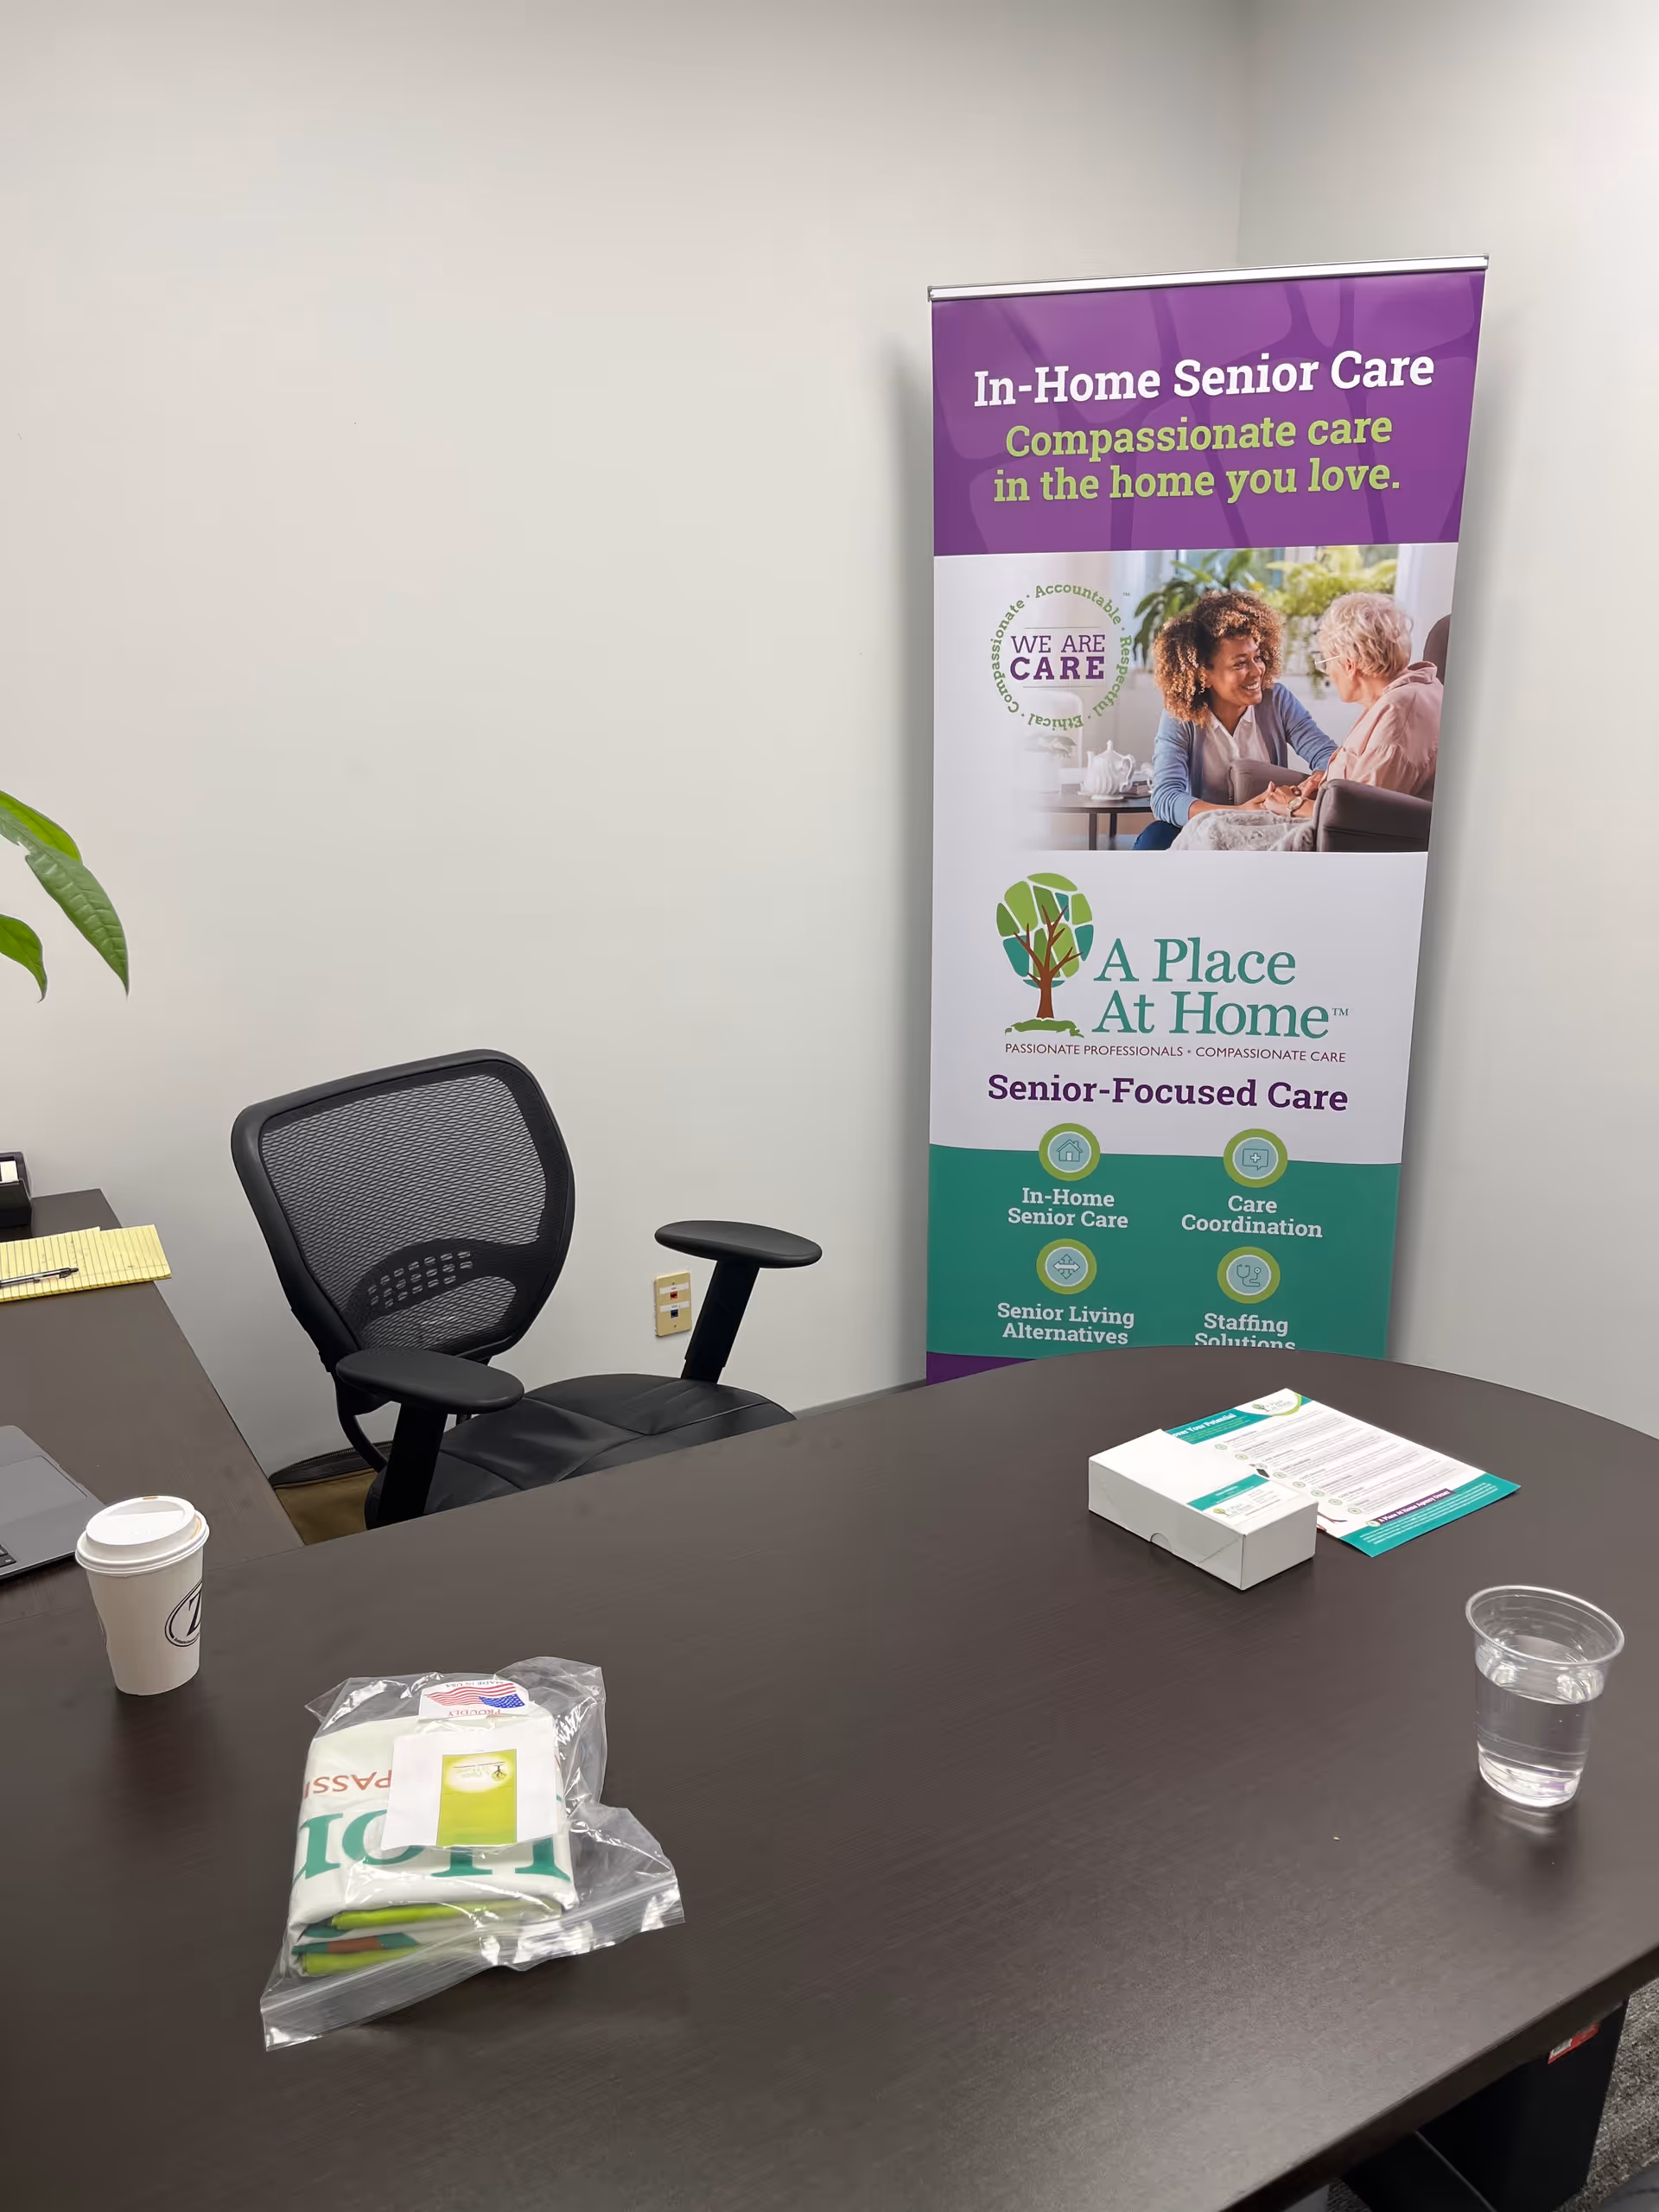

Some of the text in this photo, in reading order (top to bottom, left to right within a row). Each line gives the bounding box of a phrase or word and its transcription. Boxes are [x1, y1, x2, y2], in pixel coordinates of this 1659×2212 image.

[974, 350, 1435, 406] In-Home Senior Care
[1006, 416, 1392, 462] Compassionate care
[994, 458, 1401, 504] in the home you love.
[1035, 584, 1122, 625] Accountable
[1010, 634, 1105, 653] WE ARE
[990, 600, 1026, 714] Compassionate
[1010, 656, 1104, 681] CARE
[1092, 635, 1133, 717] Respectful
[1027, 713, 1084, 731] Ethical
[1093, 937, 1296, 985] A Place
[1091, 990, 1155, 1034] At
[1170, 992, 1330, 1039] Home
[1005, 1043, 1346, 1063] PASSIONATE PROFESSIONALS COMPASSIONATE CARE
[988, 1074, 1348, 1112] Senior-Focused Care
[1021, 1187, 1115, 1208] In-Home
[1228, 1195, 1277, 1214] Care
[1007, 1207, 1128, 1230] Senior Care
[1181, 1214, 1323, 1238] Coordination
[997, 1302, 1135, 1329] Senior Living
[1204, 1313, 1288, 1337] Staffing
[1002, 1322, 1128, 1345] Alternatives
[1194, 1332, 1296, 1350] Solutions
[1203, 1413, 1236, 1427] Potential
[448, 1708, 502, 1717] PROUDLY
